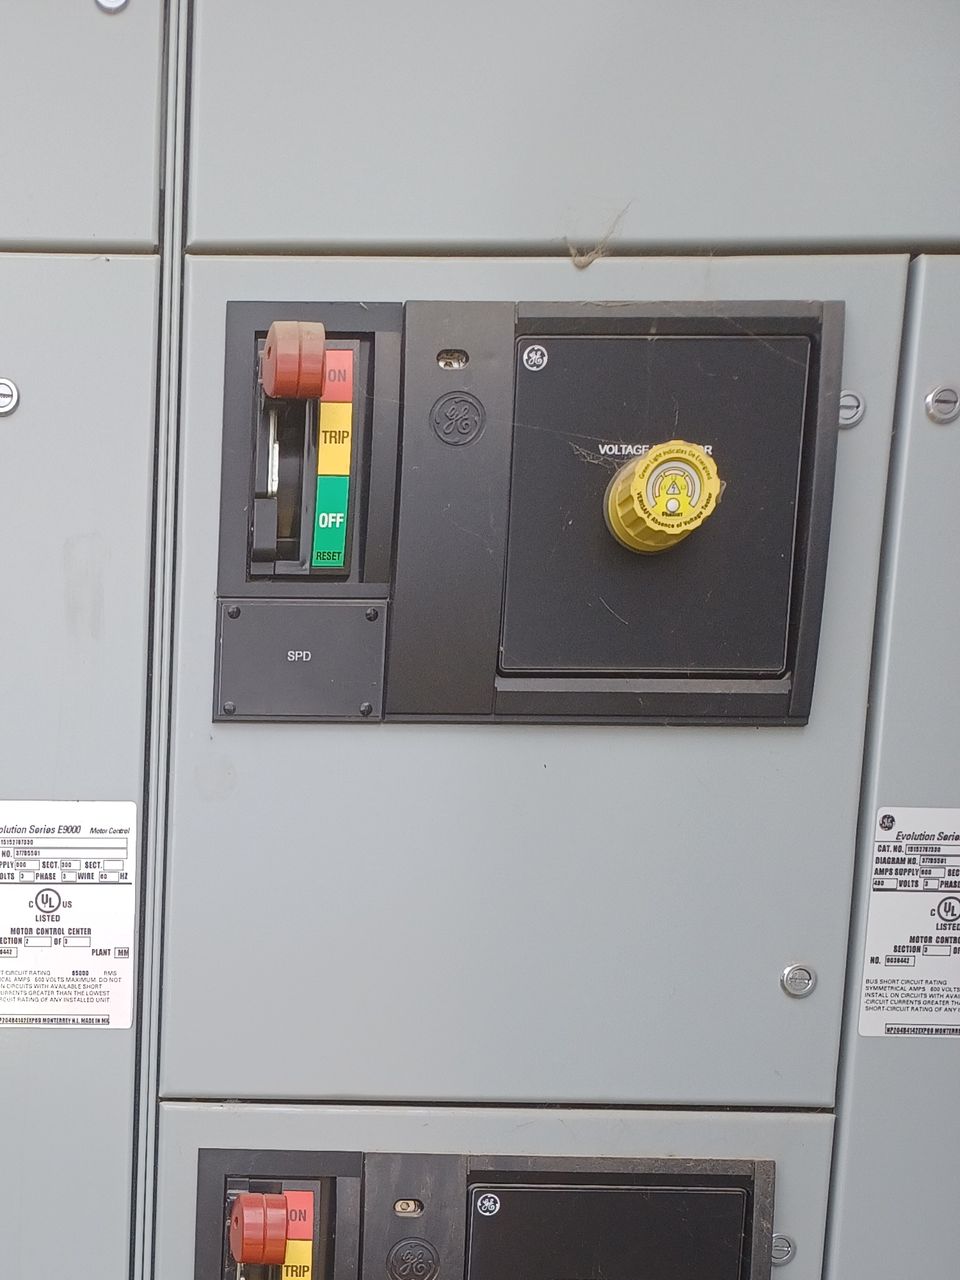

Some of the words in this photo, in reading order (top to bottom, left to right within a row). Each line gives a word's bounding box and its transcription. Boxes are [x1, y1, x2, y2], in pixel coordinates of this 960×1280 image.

[327, 369, 347, 383] ON
[321, 430, 350, 444] TRIP
[318, 512, 344, 528] OFF
[316, 551, 342, 561] RESET
[287, 651, 312, 661] SPD
[29, 825, 56, 834] Series
[57, 825, 82, 834] E9000
[896, 831, 936, 841] Evolution
[877, 845, 892, 853] CAT.
[42, 861, 60, 869] SECT.
[875, 857, 906, 865] DIAGRAM
[874, 868, 893, 876] AMPS
[894, 868, 919, 876] SUPPLY
[35, 914, 60, 922] LISTED
[10, 927, 33, 935] MOTOR
[35, 927, 65, 935] CONTROL
[909, 935, 933, 944] MOTOR
[91, 948, 111, 956] PLANT
[289, 1209, 307, 1222] ON
[283, 1265, 310, 1278] TRIP
